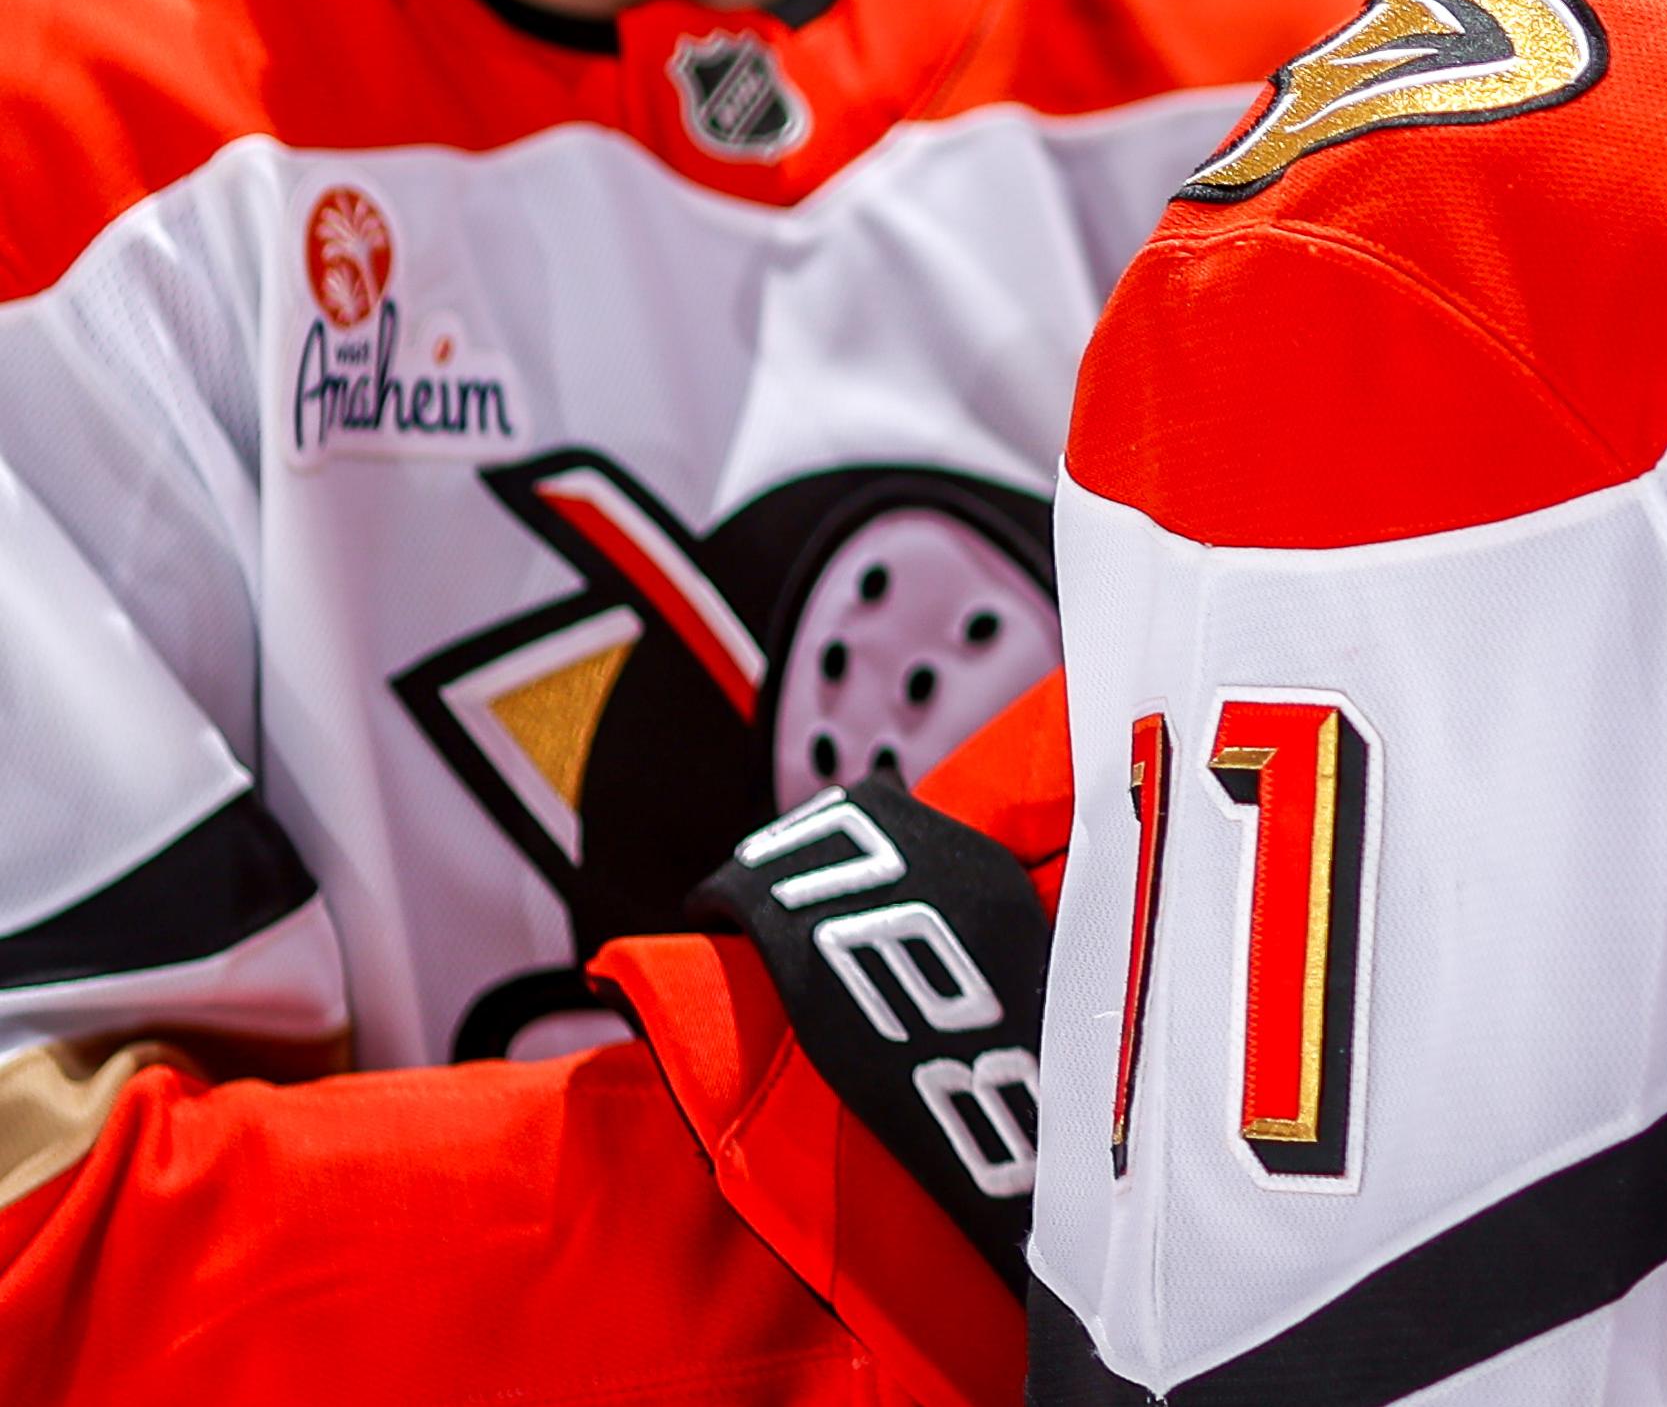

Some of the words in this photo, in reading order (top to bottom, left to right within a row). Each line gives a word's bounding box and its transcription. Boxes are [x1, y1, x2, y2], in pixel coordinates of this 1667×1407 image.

[294, 298, 514, 450] Anaheim
[734, 784, 1043, 1198] BAU
[1111, 699, 1370, 1180] 11
